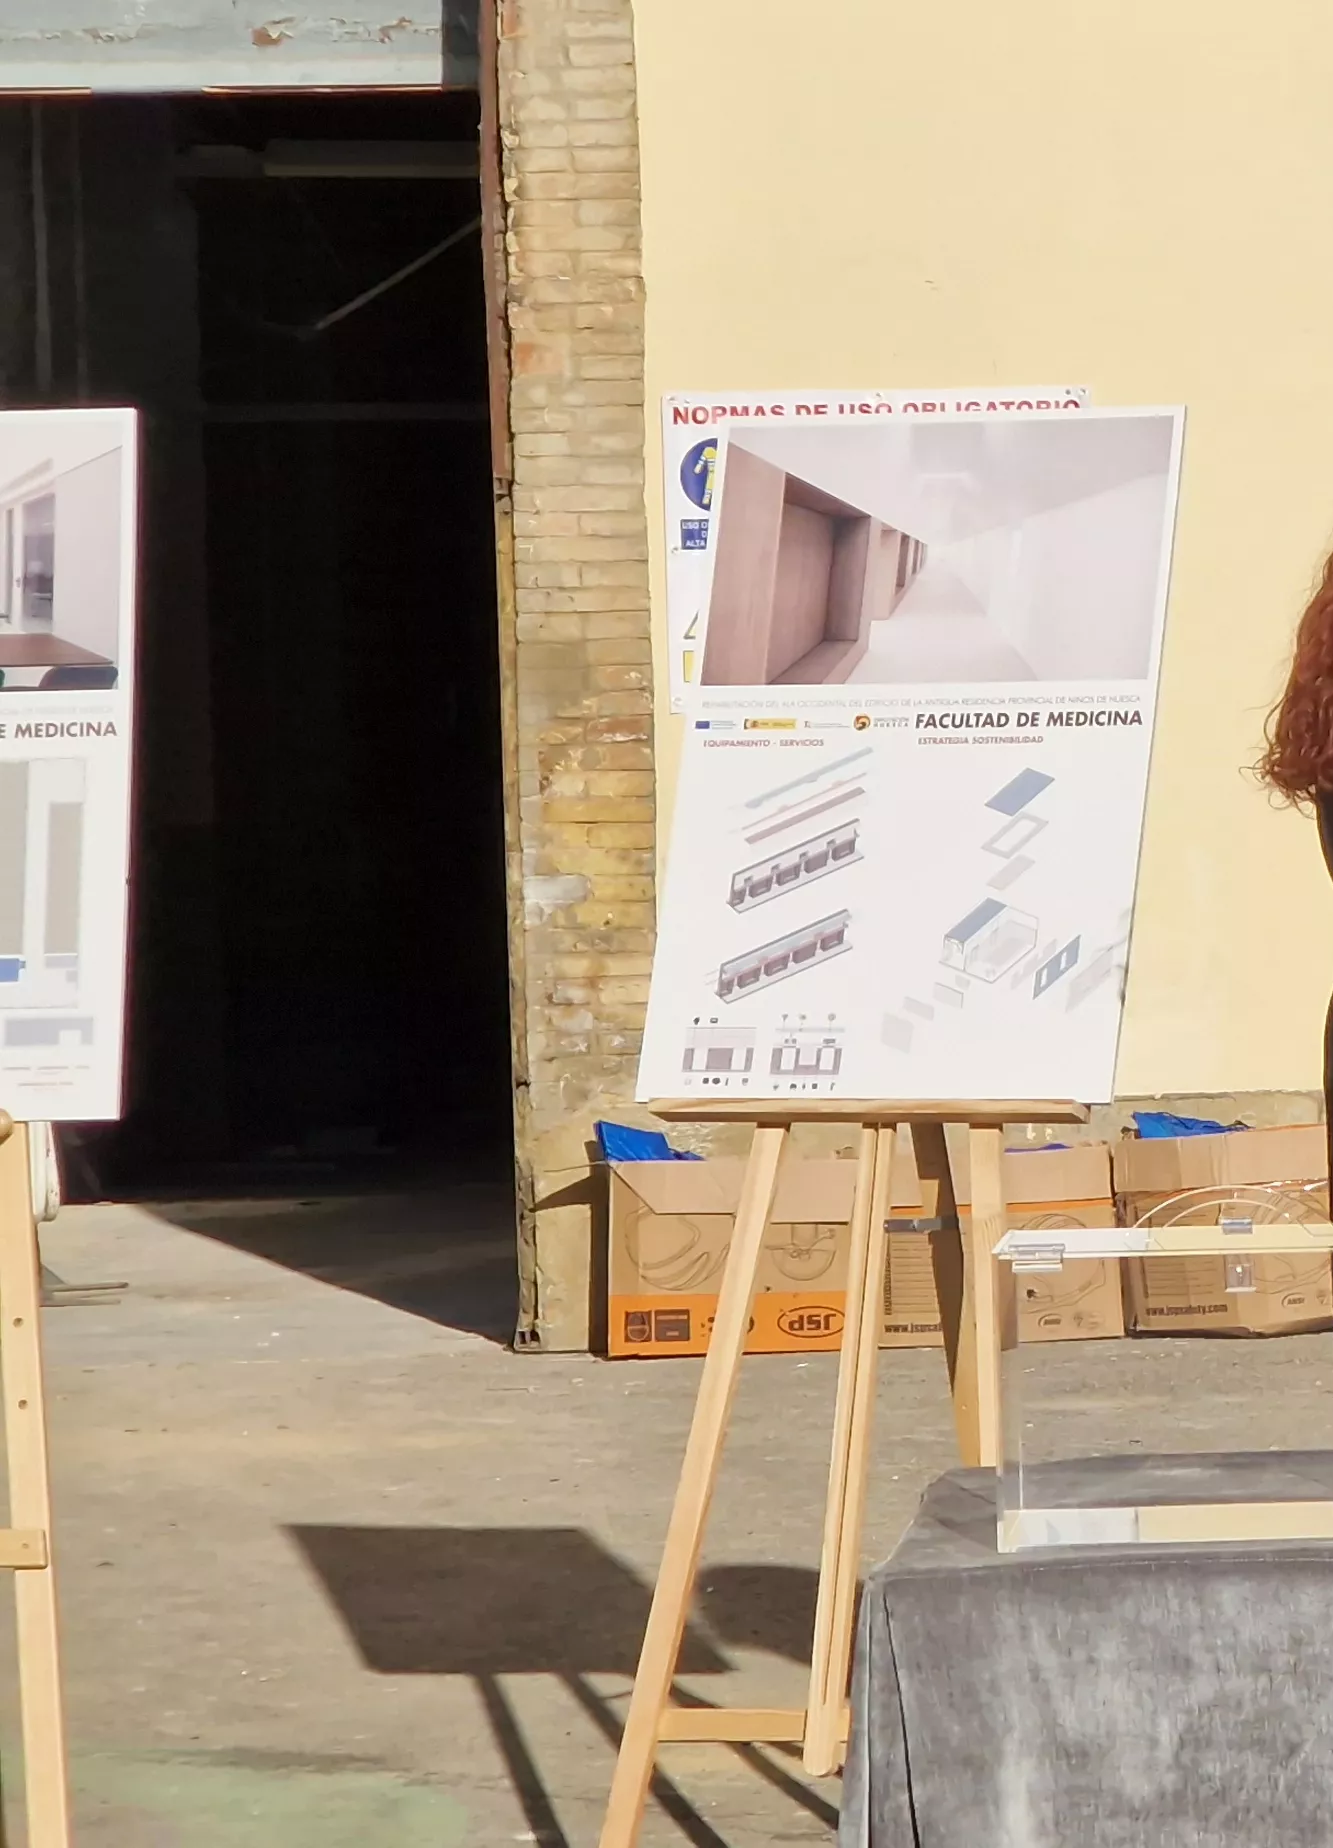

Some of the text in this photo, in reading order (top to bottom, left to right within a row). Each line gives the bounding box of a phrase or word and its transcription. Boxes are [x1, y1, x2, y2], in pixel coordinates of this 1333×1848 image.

[915, 710, 1143, 729] FACULTAD DE MEDICINA
[14, 721, 118, 739] MEDICINA
[703, 738, 771, 748] EQUIPAMIENTO
[779, 738, 825, 748] SERVICIOS
[917, 735, 1044, 745] ESTRATEGIA SOSTENIBILIDAD
[787, 1313, 837, 1332] JSP
